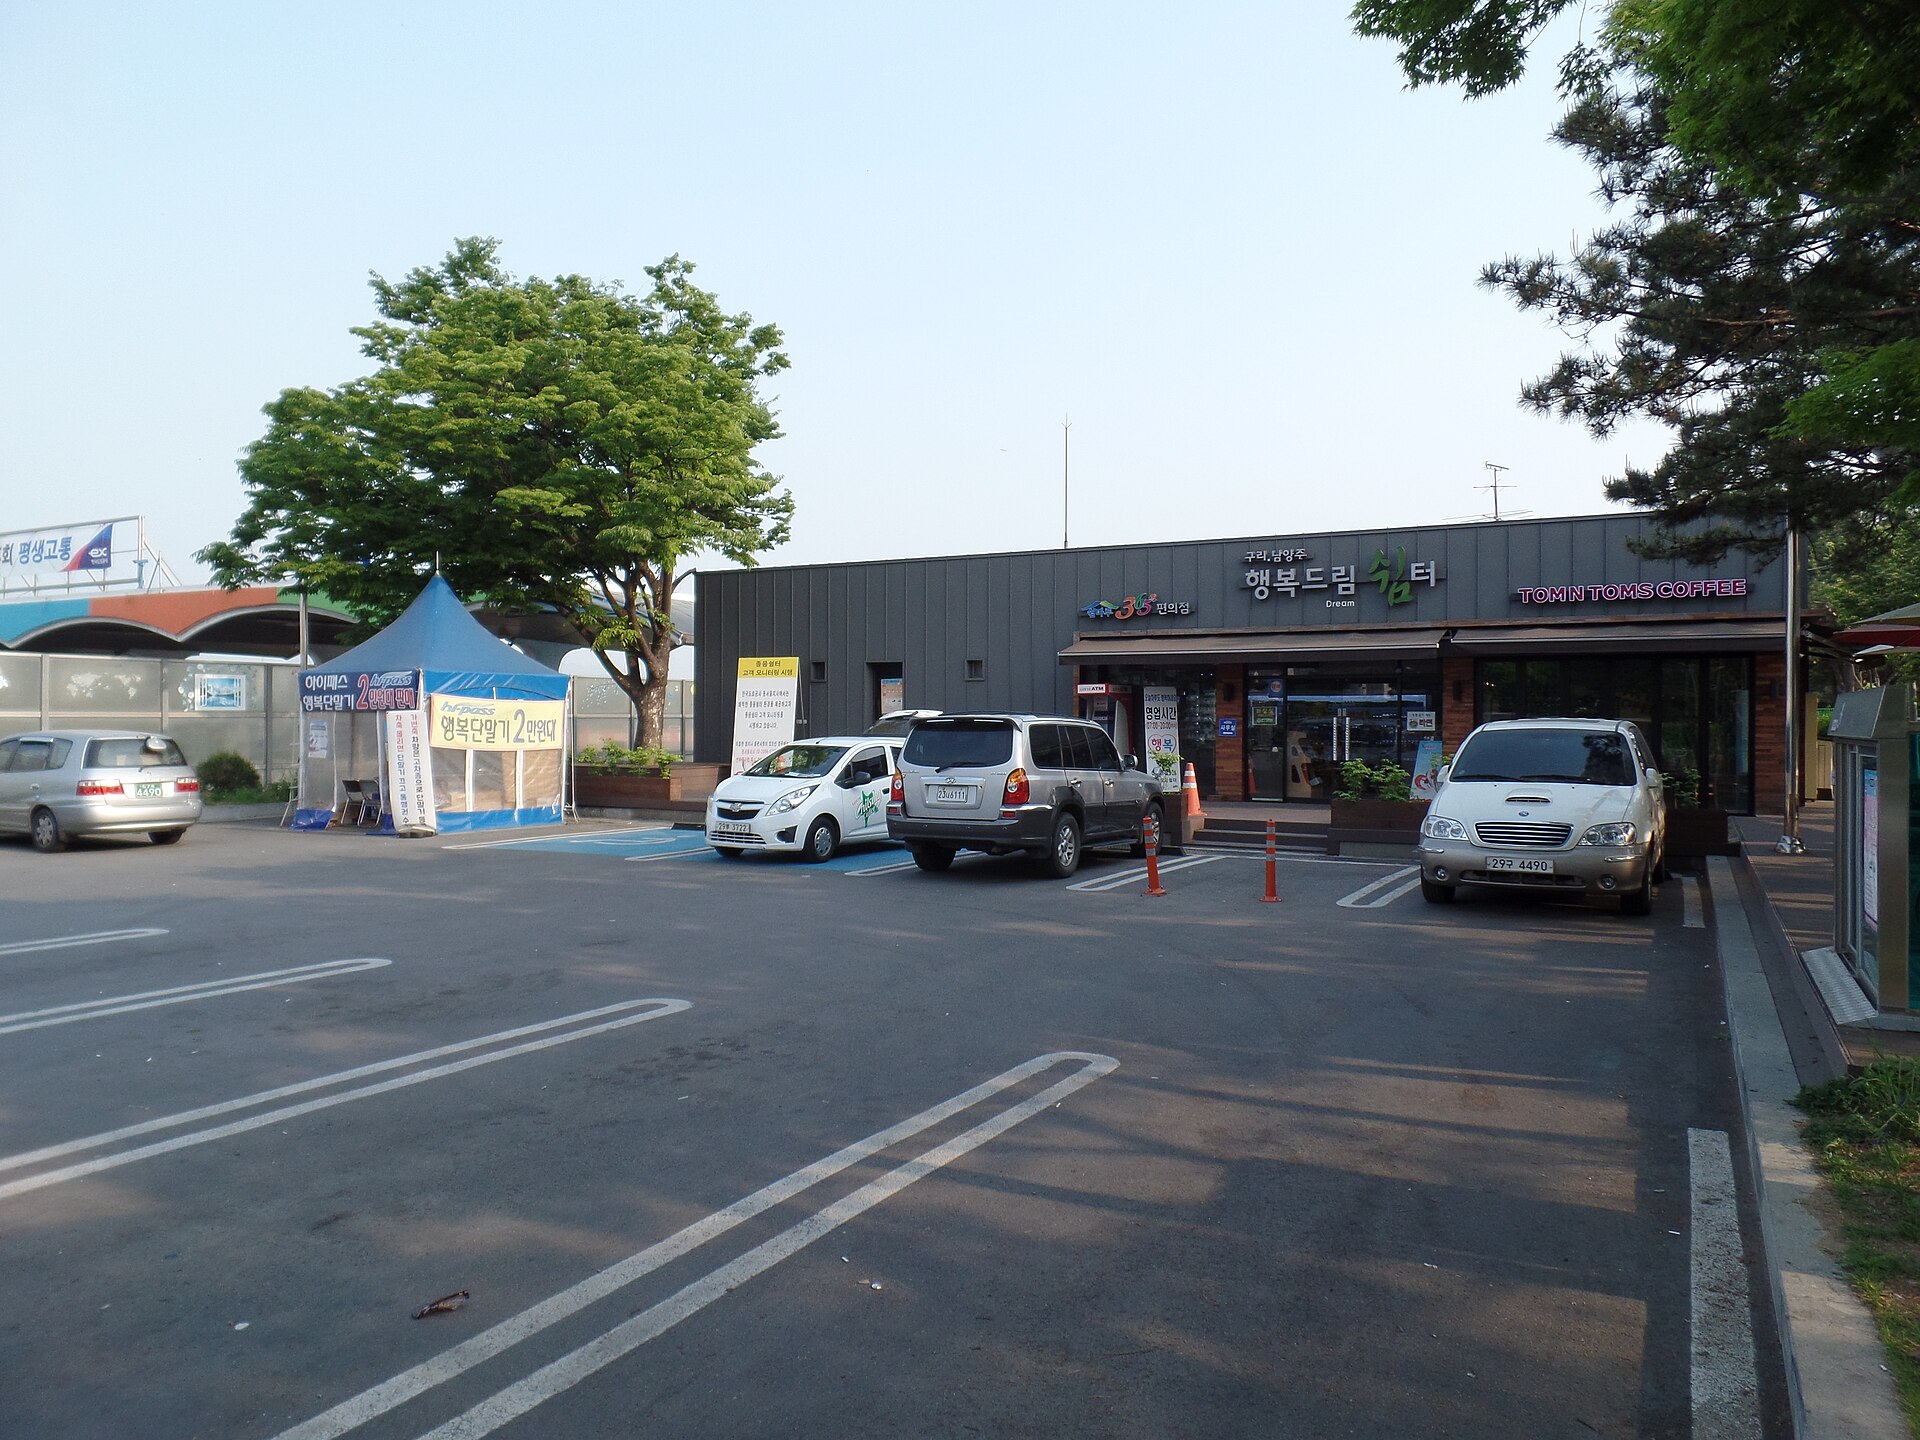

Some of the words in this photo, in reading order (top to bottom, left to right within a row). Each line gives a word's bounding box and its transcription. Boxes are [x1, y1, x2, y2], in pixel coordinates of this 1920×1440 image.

[19, 537, 73, 565] 평생고통
[88, 547, 108, 557] ex
[1244, 549, 1307, 562] 구리.남양주
[1245, 565, 1355, 600] 행복드림
[1369, 546, 1435, 606] 쉼터
[1518, 586, 1566, 603] TOM
[1569, 586, 1584, 602] N
[1587, 582, 1654, 601] TOMS
[1656, 579, 1747, 598] COFFEE
[1156, 602, 1189, 615] 편의점
[1326, 600, 1355, 608] Dream
[303, 694, 354, 711] 행복단말기
[394, 688, 415, 710] 판매
[441, 702, 495, 716] hi-pass
[1146, 706, 1176, 720] 영업시간
[441, 715, 510, 743] 행복단말기
[136, 788, 161, 796] 4490
[732, 823, 748, 832] 3722
[1492, 858, 1513, 869] 29구
[1519, 860, 1548, 871] 4490
